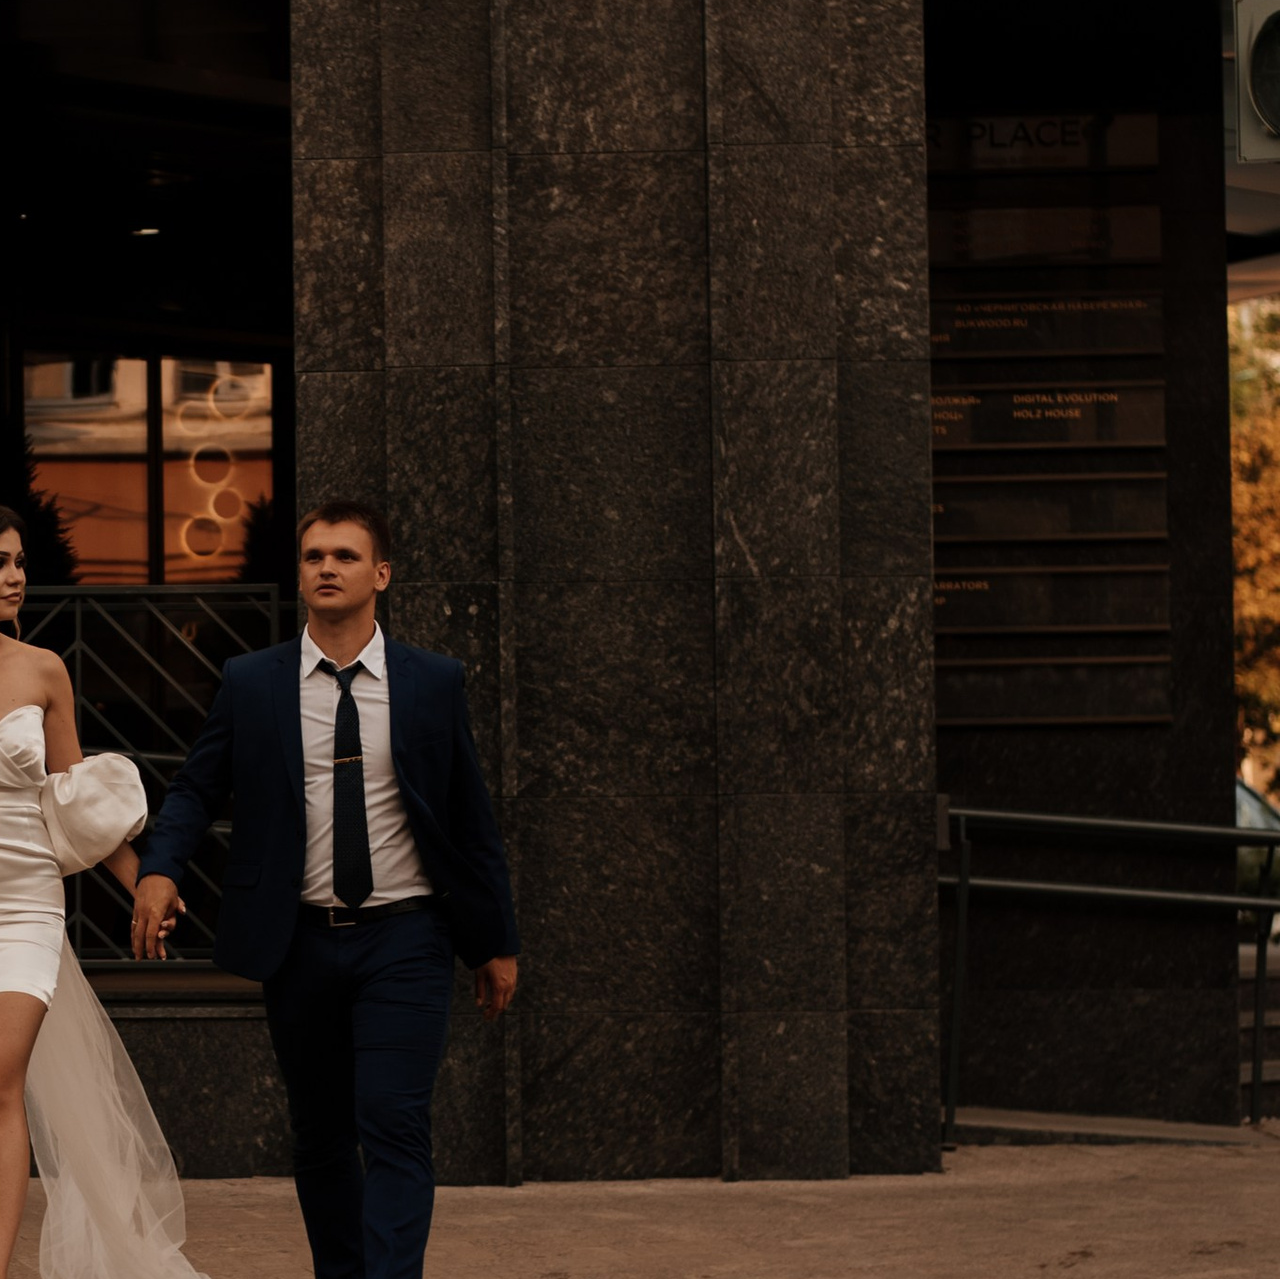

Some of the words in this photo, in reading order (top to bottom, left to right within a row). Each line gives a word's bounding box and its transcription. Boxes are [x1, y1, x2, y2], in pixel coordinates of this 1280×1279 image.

[967, 119, 1081, 148] PLACE
[1012, 394, 1055, 405] DIGITAL
[1056, 392, 1118, 404] EVOLUTION
[1012, 408, 1042, 420] HOLZ
[1044, 407, 1082, 419] HOUSE
